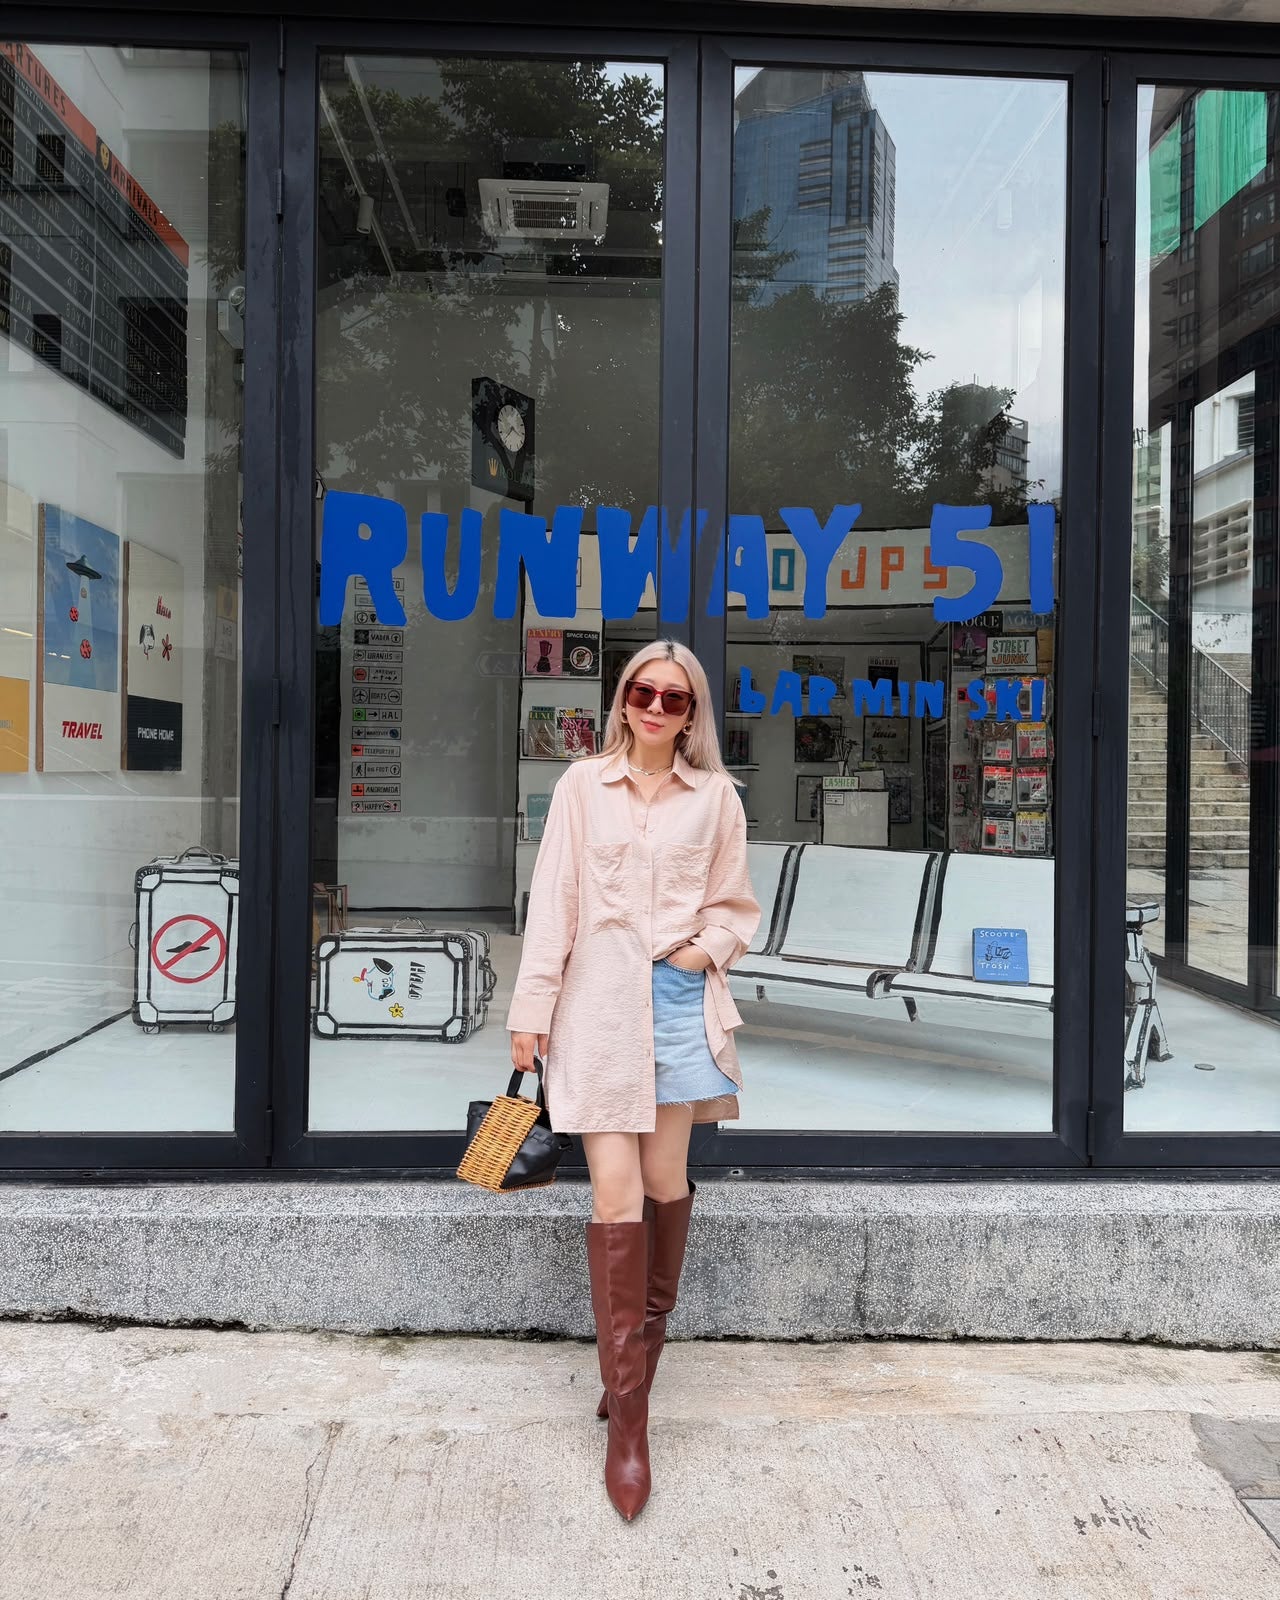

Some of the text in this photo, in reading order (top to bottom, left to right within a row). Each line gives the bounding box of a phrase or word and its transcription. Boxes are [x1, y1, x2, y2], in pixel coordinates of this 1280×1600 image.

[39, 186, 60, 220] STAR
[114, 162, 158, 226] ARRIVALS
[320, 490, 862, 626] RUNWAY
[992, 653, 1030, 665] JUNK
[382, 711, 400, 720] HAL
[62, 721, 103, 740] TRAVEL
[137, 727, 175, 742] PHONE HOME
